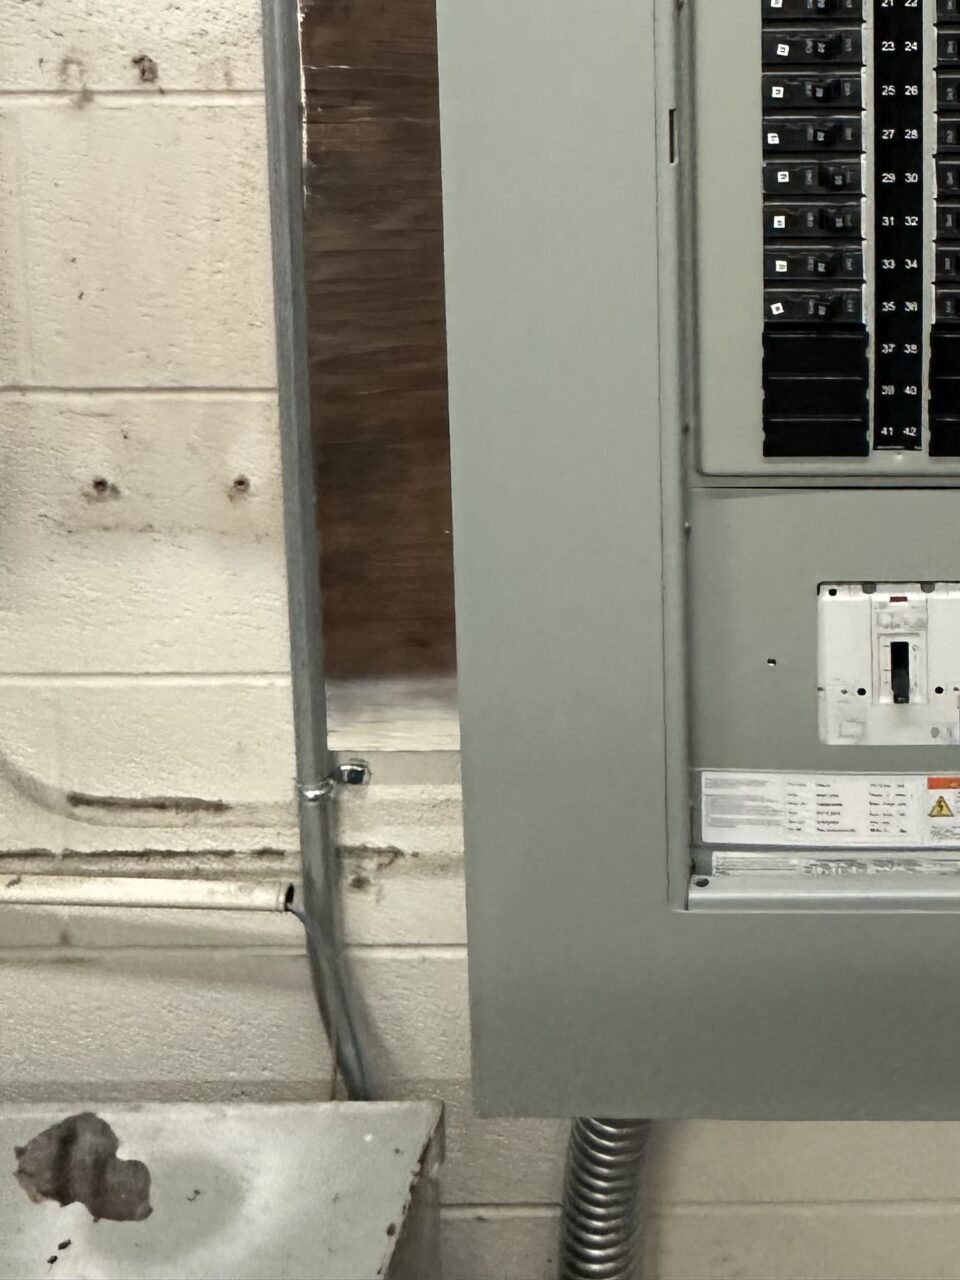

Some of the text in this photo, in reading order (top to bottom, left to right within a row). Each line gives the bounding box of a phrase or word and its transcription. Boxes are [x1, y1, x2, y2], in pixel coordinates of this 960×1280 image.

[881, 40, 918, 52] 23 24
[881, 85, 919, 96] 25 26
[881, 129, 895, 140] 27
[904, 172, 919, 183] 30
[881, 215, 919, 227] 31 32
[904, 258, 919, 270] 34
[880, 426, 894, 437] 41
